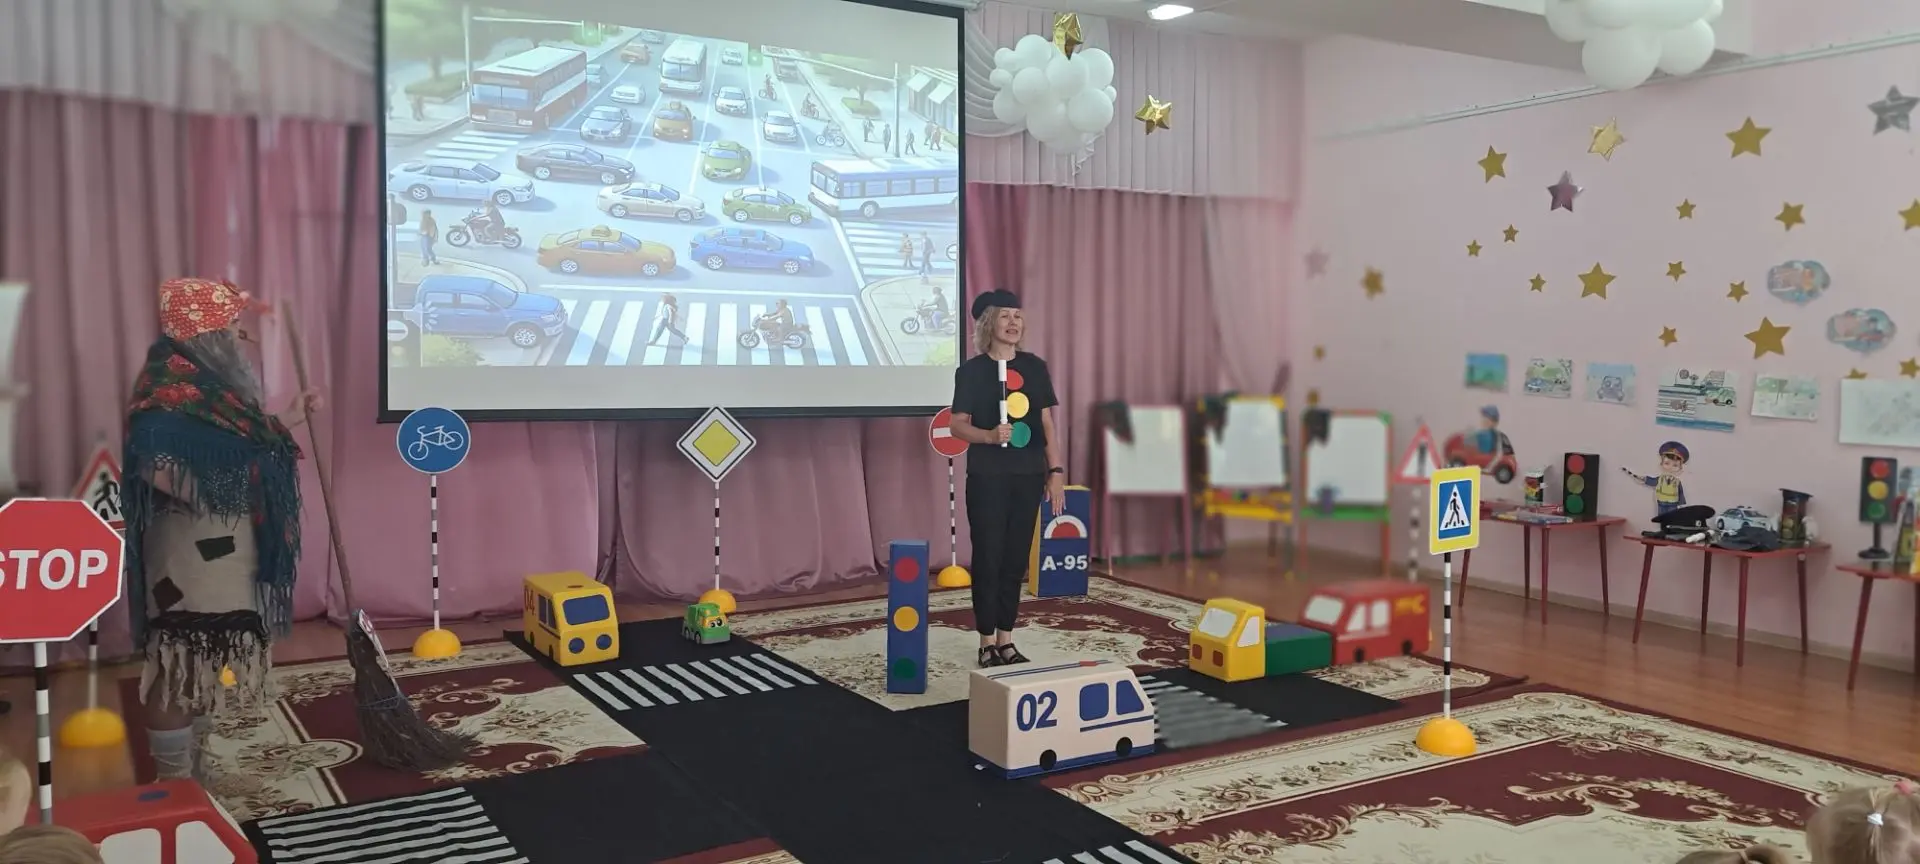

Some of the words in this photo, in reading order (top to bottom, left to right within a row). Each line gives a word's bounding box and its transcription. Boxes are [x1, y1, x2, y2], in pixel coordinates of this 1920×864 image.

[0, 548, 108, 590] TOP
[1041, 554, 1088, 571] A-95
[524, 585, 536, 616] 04
[1016, 690, 1058, 732] 02
